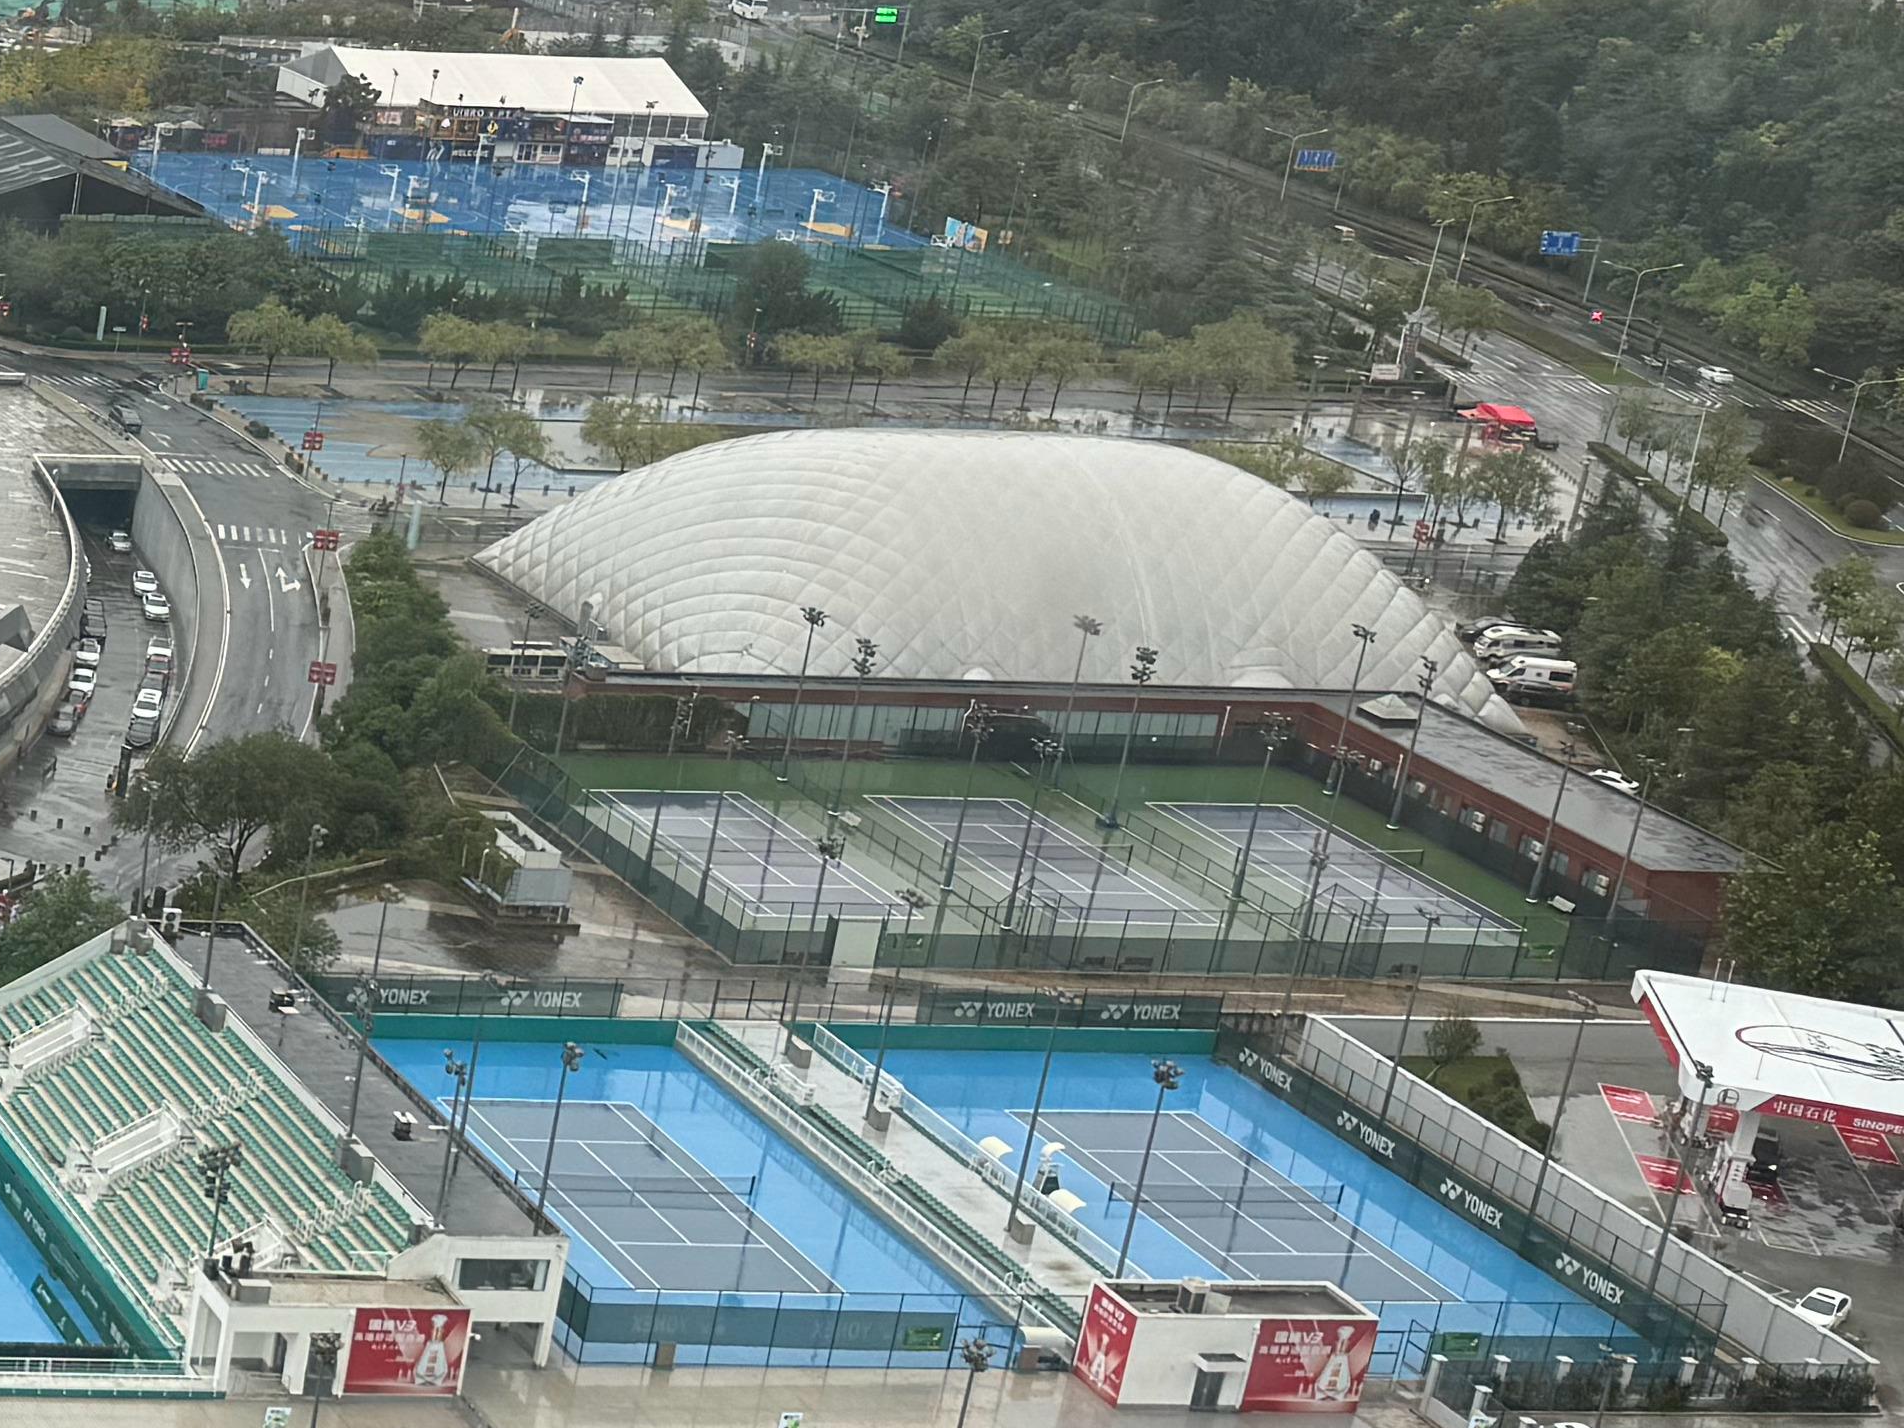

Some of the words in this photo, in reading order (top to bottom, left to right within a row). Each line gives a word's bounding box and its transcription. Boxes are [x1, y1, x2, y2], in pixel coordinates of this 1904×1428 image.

[379, 989, 430, 1005] YONEX
[533, 991, 582, 1008] YONEX
[986, 1002, 1035, 1018] YONEX
[1133, 1004, 1182, 1020] YONEX
[1258, 1056, 1293, 1093] YONEX
[1773, 1101, 1837, 1123] 中国石化
[1359, 1121, 1395, 1159] YONEX
[1464, 1189, 1503, 1229] YONEX
[1581, 1264, 1624, 1306] YONEX
